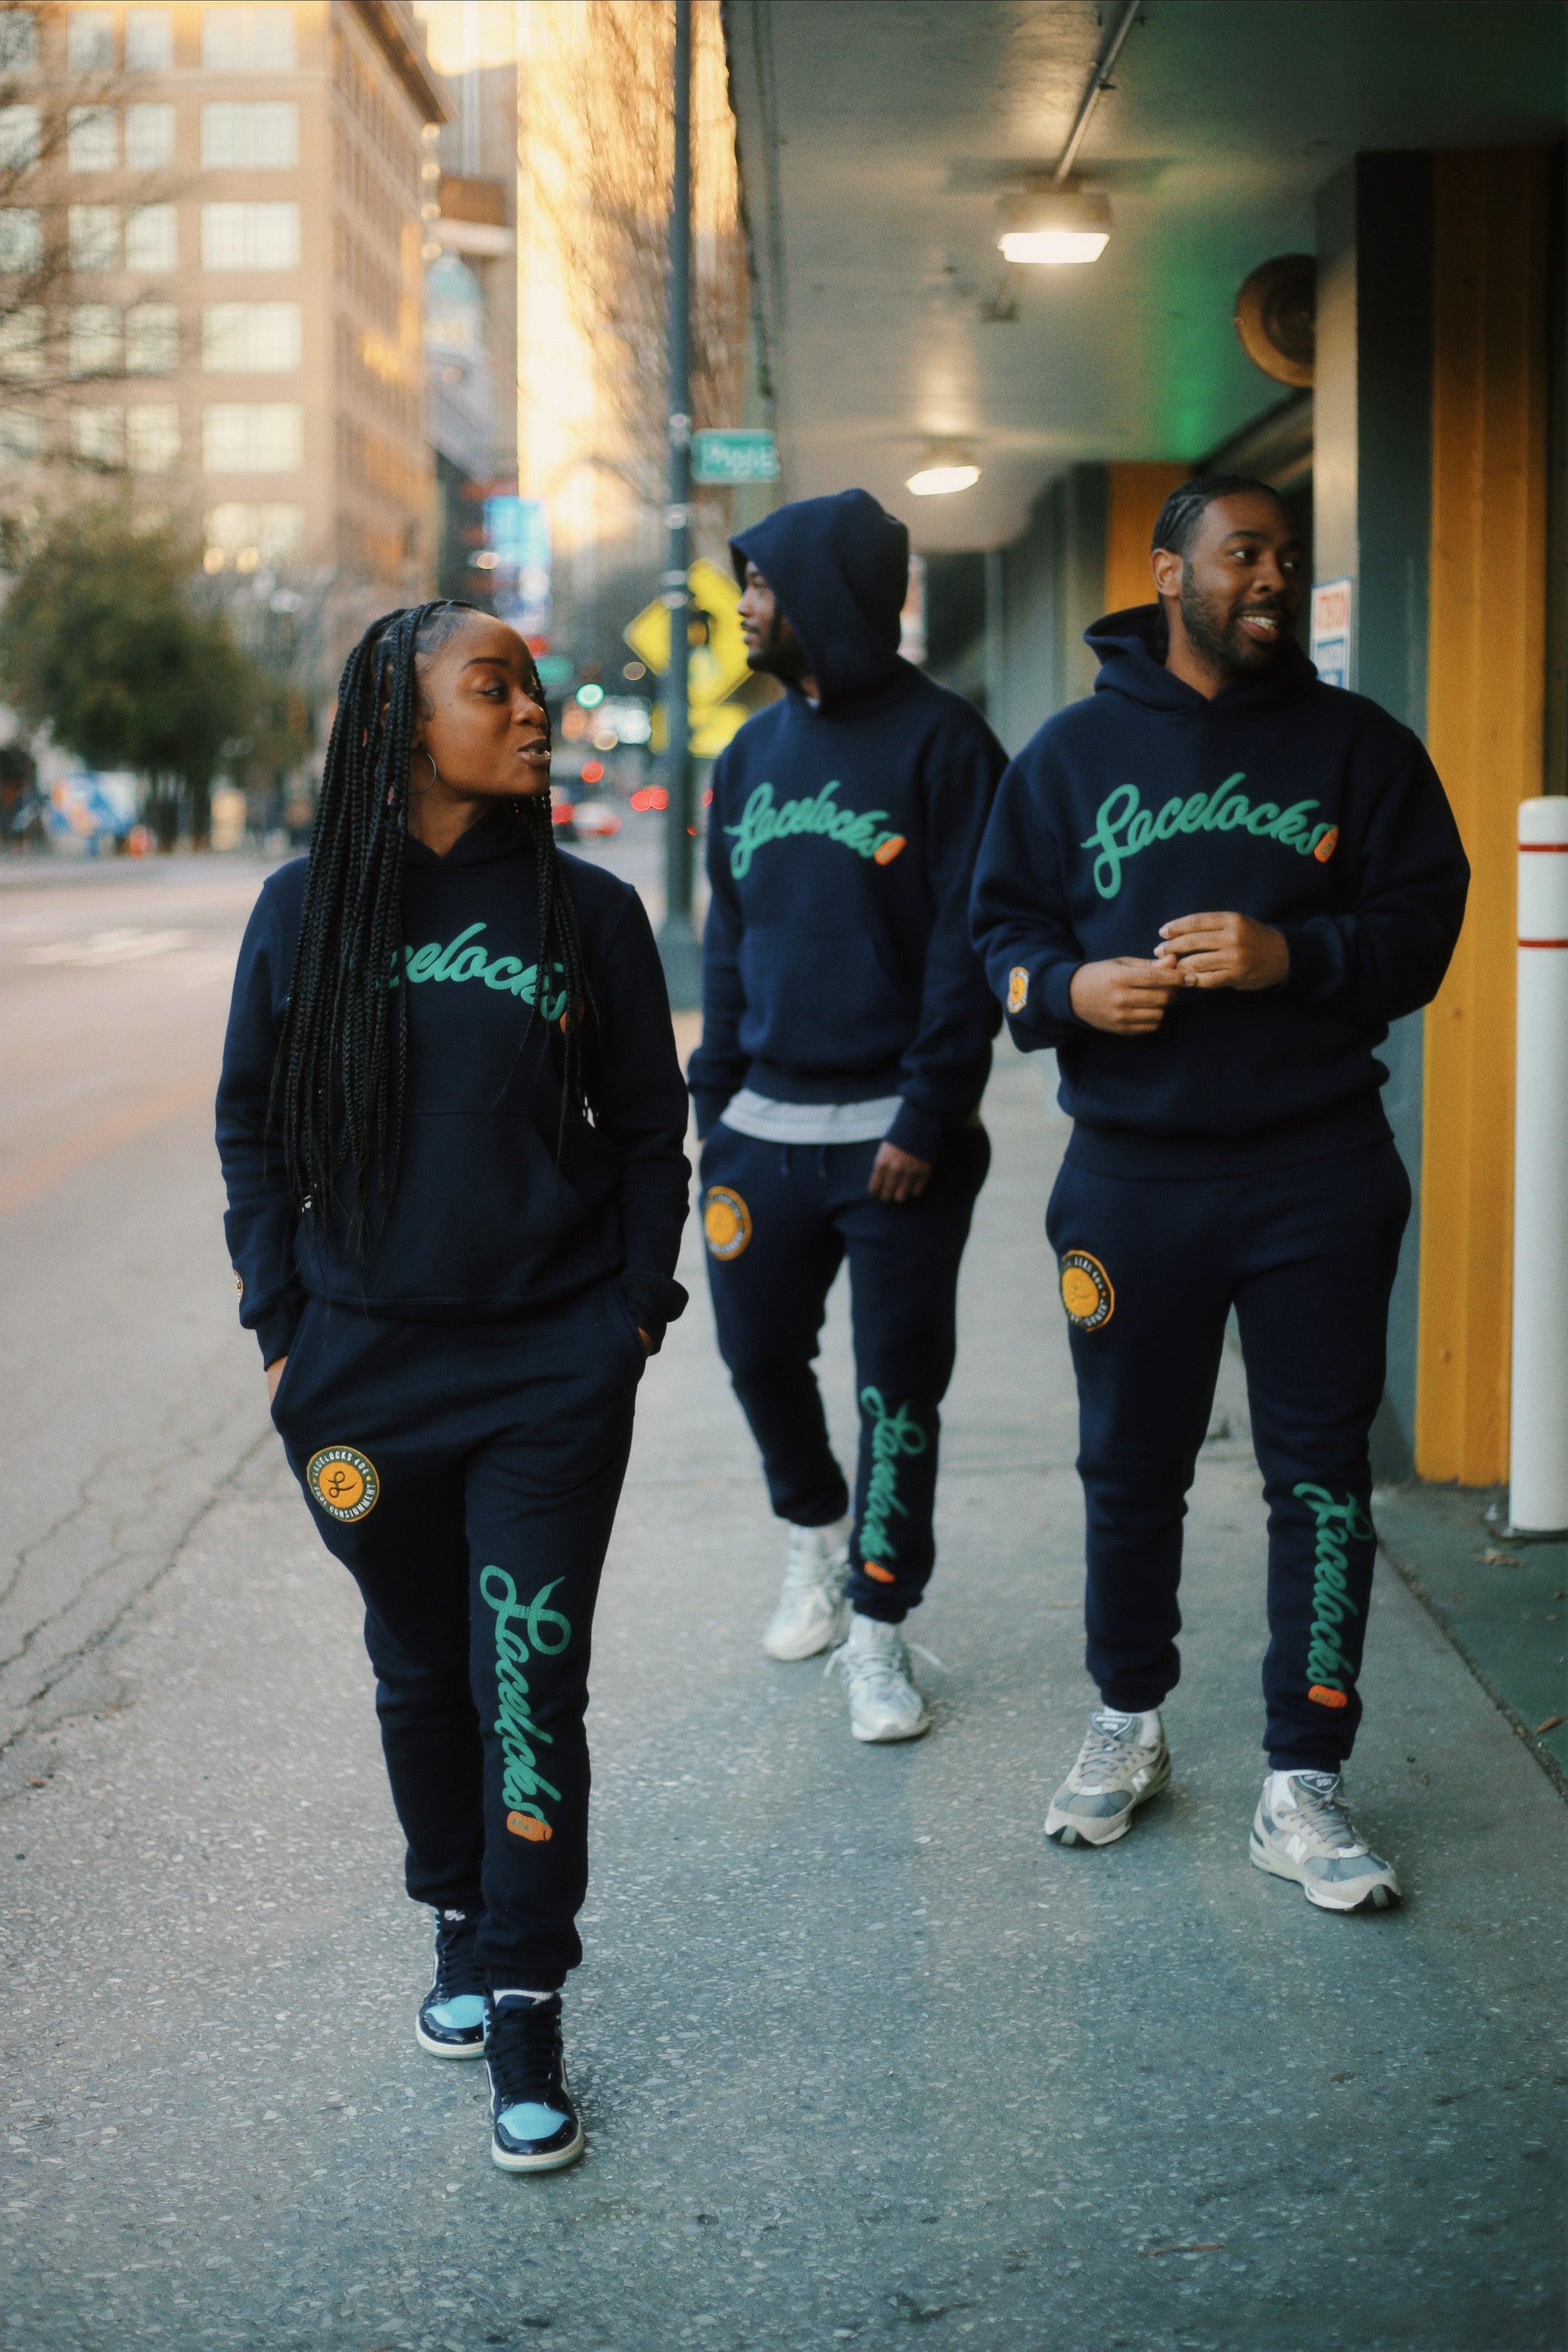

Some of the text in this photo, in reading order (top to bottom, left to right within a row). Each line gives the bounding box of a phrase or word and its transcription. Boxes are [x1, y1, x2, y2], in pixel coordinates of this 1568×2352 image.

[1080, 772, 1339, 899] Lacelocks
[313, 1451, 369, 1476] LACELOCKS 404
[480, 1564, 571, 1825] Lacelocks
